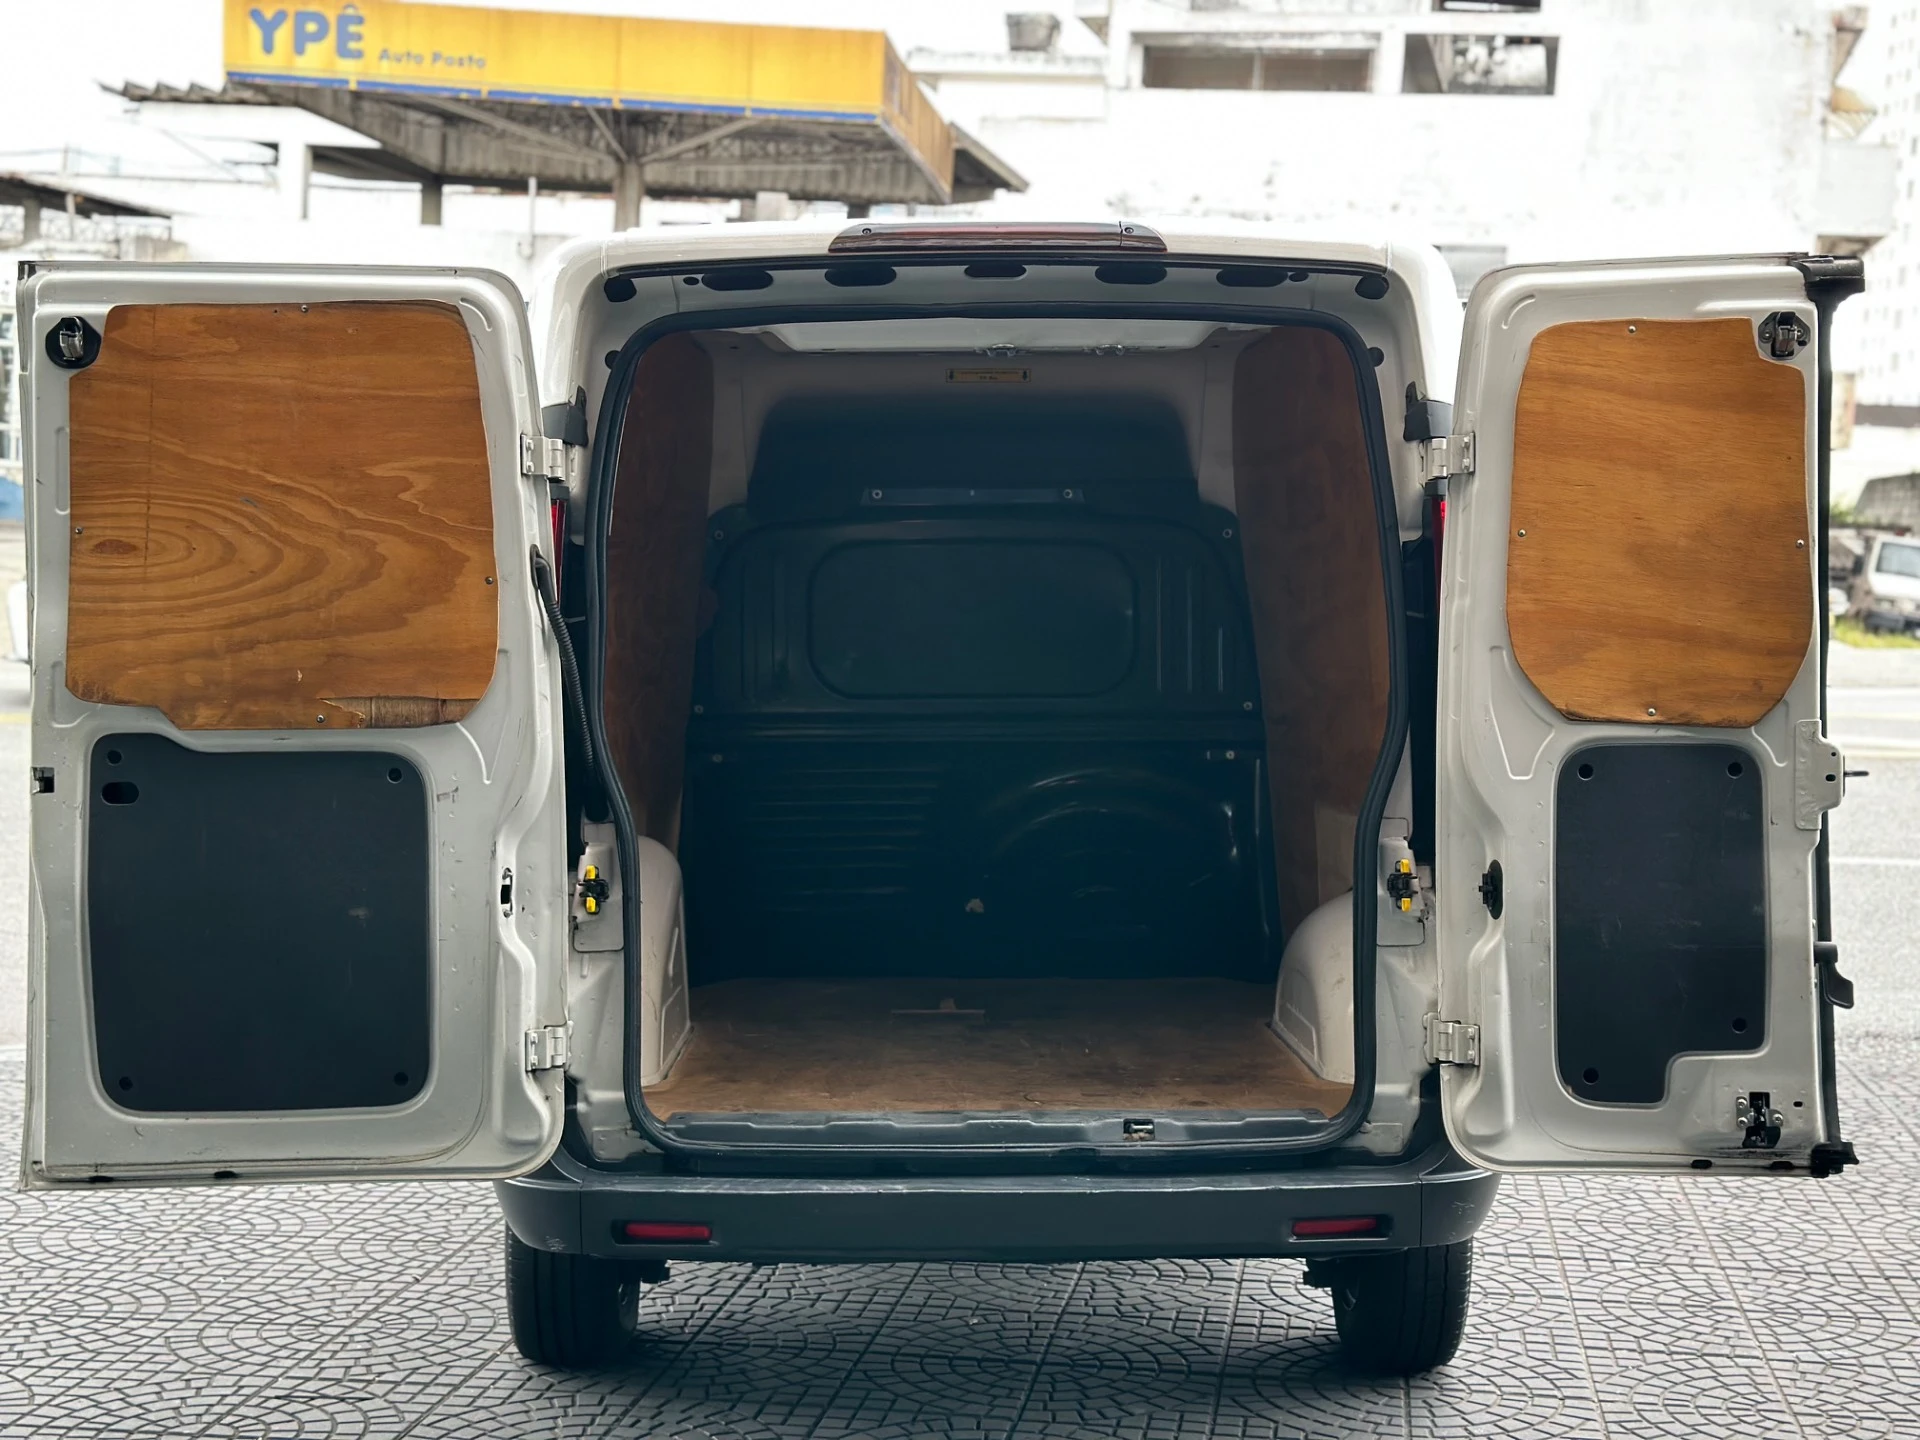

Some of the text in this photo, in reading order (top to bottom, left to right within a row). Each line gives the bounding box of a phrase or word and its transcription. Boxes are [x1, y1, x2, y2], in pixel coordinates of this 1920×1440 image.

[249, 4, 365, 60] YPÊ
[379, 48, 486, 69] Auto Posto
